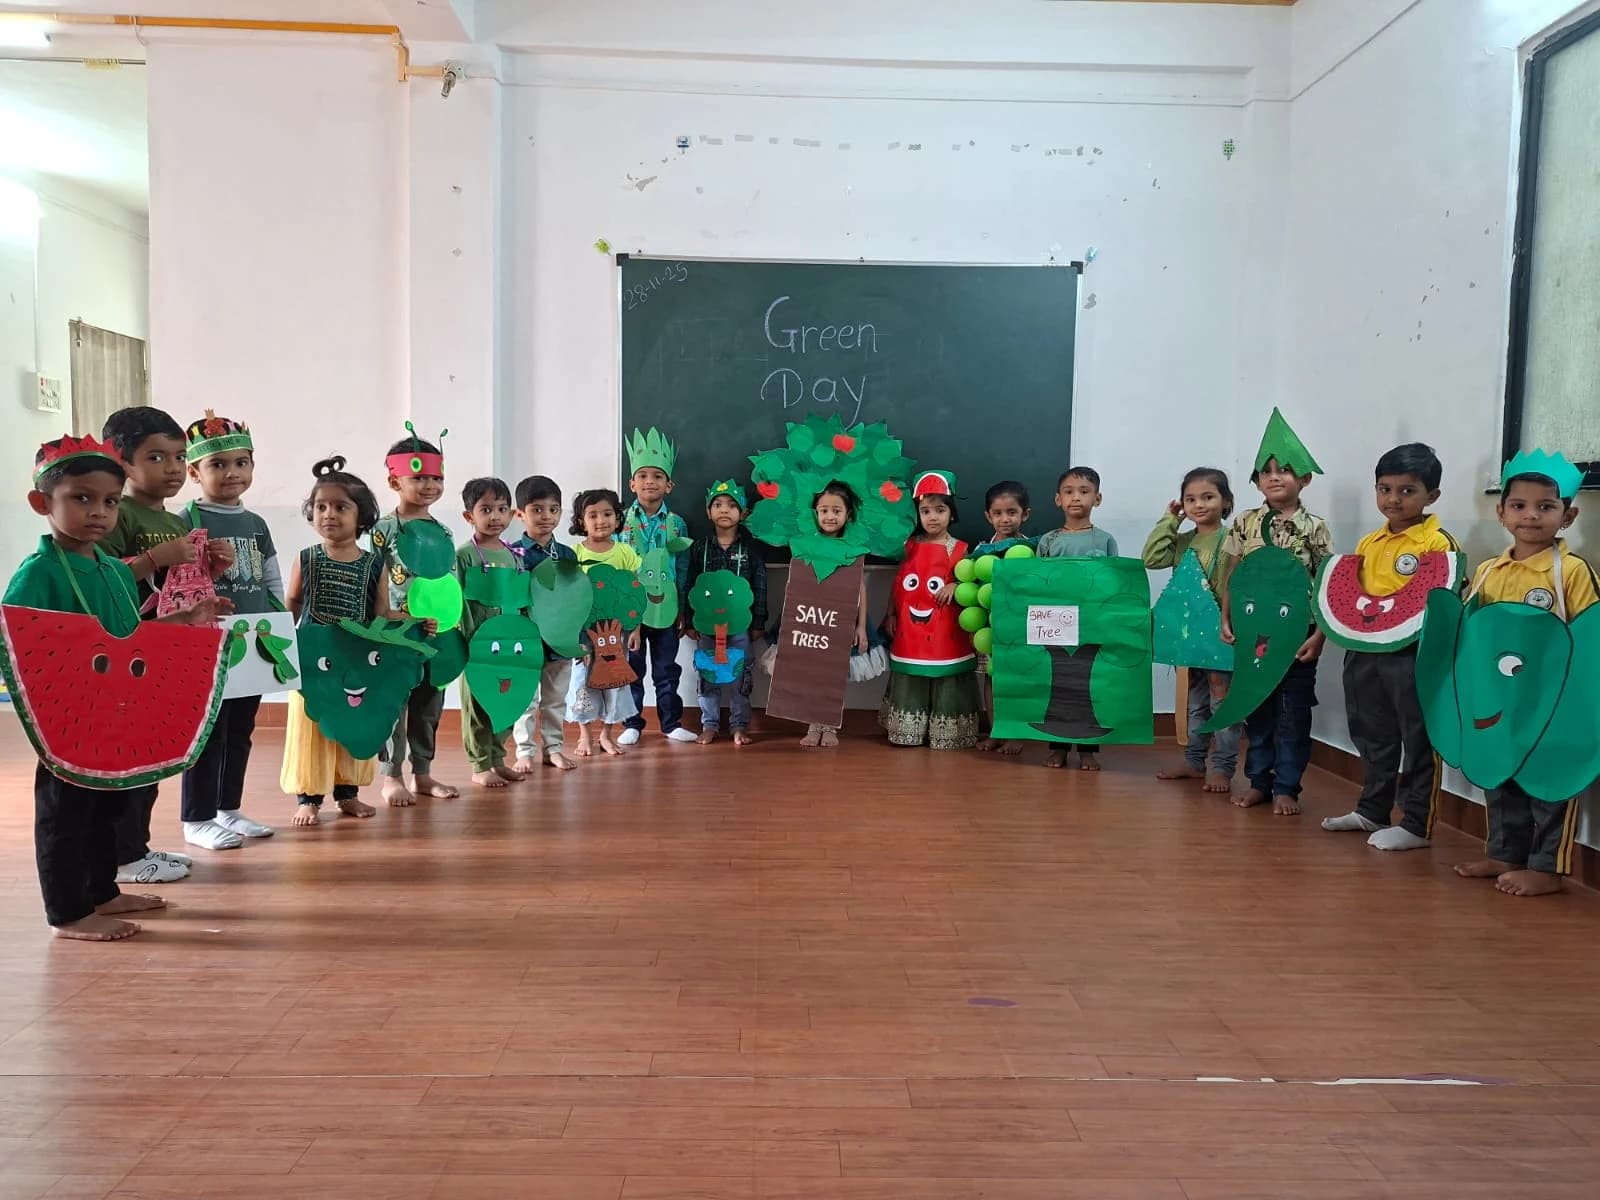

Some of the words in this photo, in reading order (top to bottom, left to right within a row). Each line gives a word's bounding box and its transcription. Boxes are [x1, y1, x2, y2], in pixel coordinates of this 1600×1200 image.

[764, 296, 878, 353] Green
[760, 368, 865, 430] Day
[795, 604, 839, 628] SAVE
[1030, 610, 1054, 621] SAVE
[791, 630, 829, 650] TREES
[1036, 625, 1061, 639] Tree
